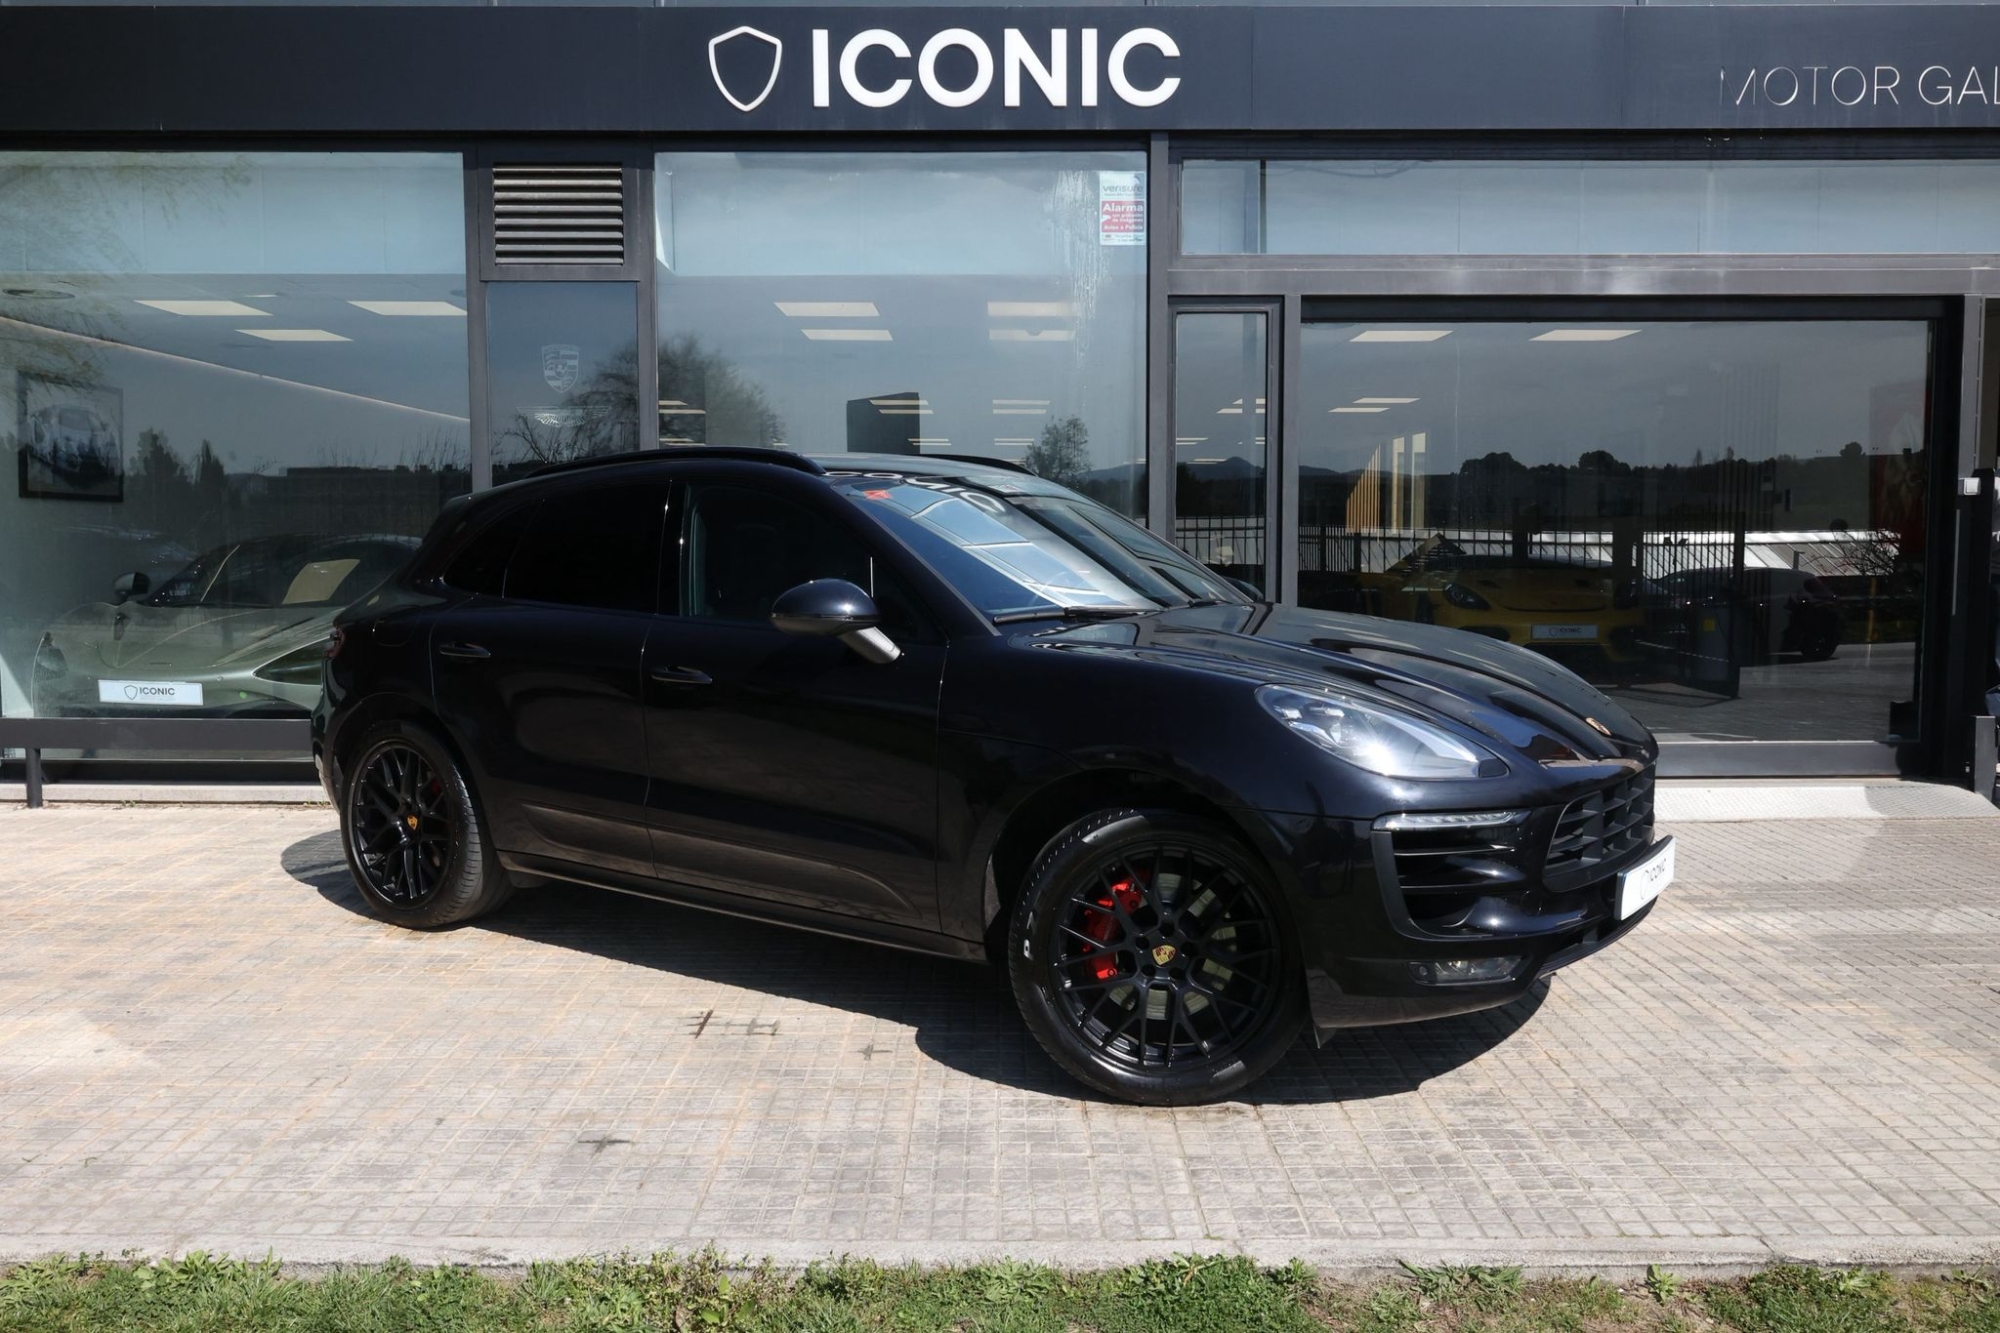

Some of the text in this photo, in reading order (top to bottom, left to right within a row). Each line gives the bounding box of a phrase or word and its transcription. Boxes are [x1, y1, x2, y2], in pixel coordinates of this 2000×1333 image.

[812, 27, 1181, 107] ICONIC
[1719, 66, 1900, 106] MOTOR
[1103, 203, 1143, 211] Alarma
[139, 686, 176, 696] ICONIC
